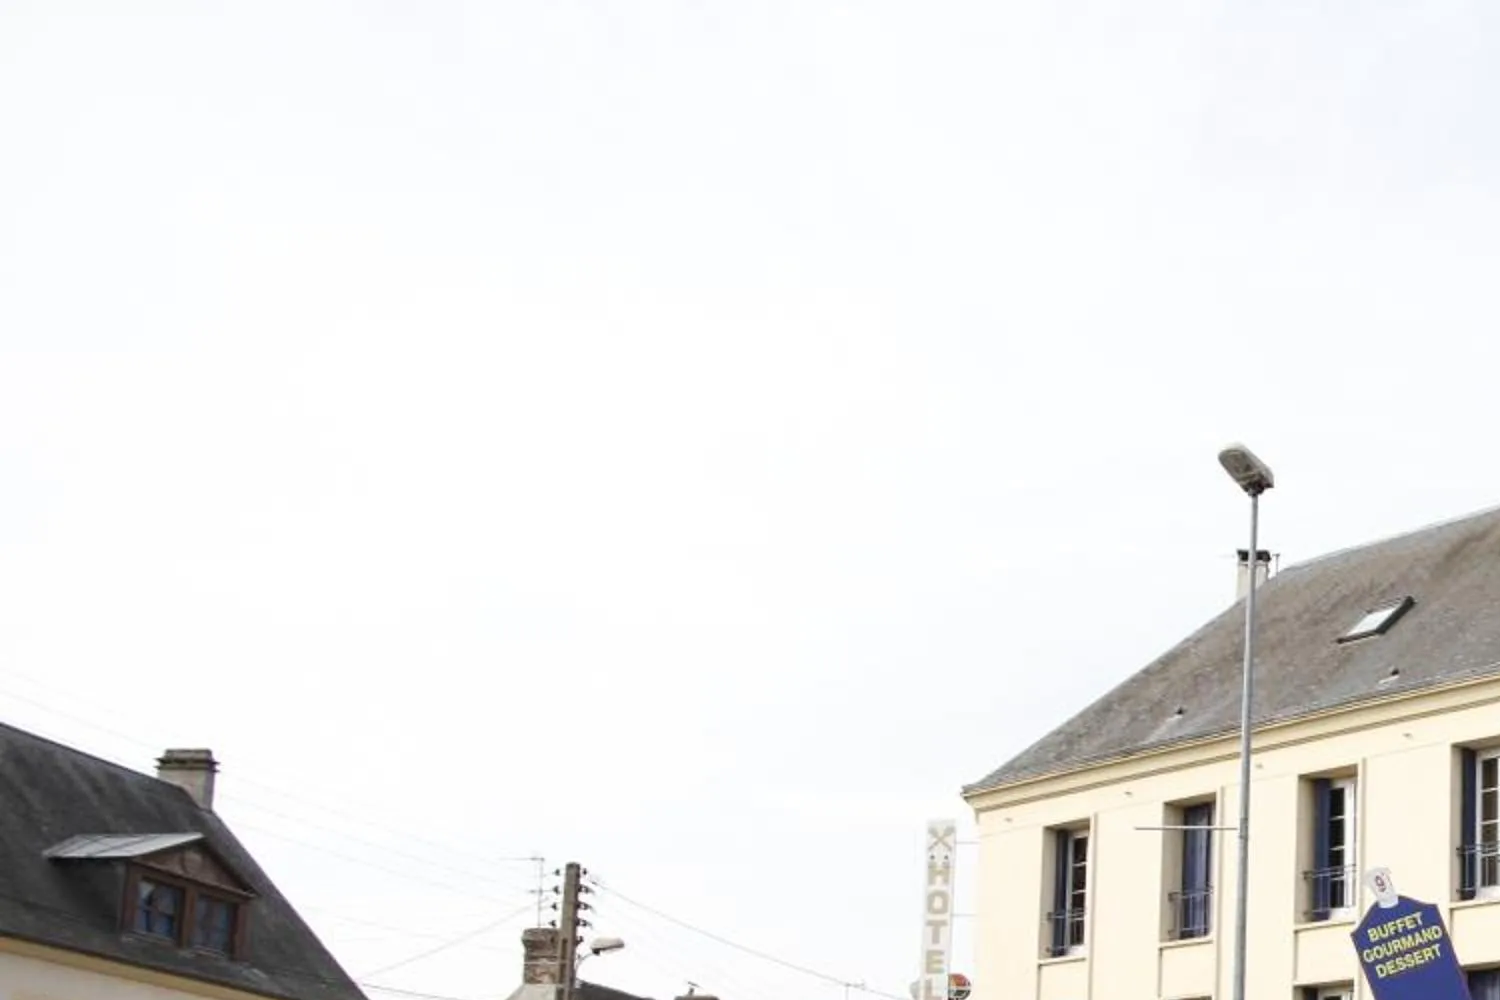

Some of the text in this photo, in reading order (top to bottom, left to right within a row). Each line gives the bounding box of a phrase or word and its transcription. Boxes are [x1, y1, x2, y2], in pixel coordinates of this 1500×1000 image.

[1363, 924, 1443, 963] GOURMAND
[1367, 911, 1423, 943] BUFFET
[1375, 943, 1441, 979] DESSERT
